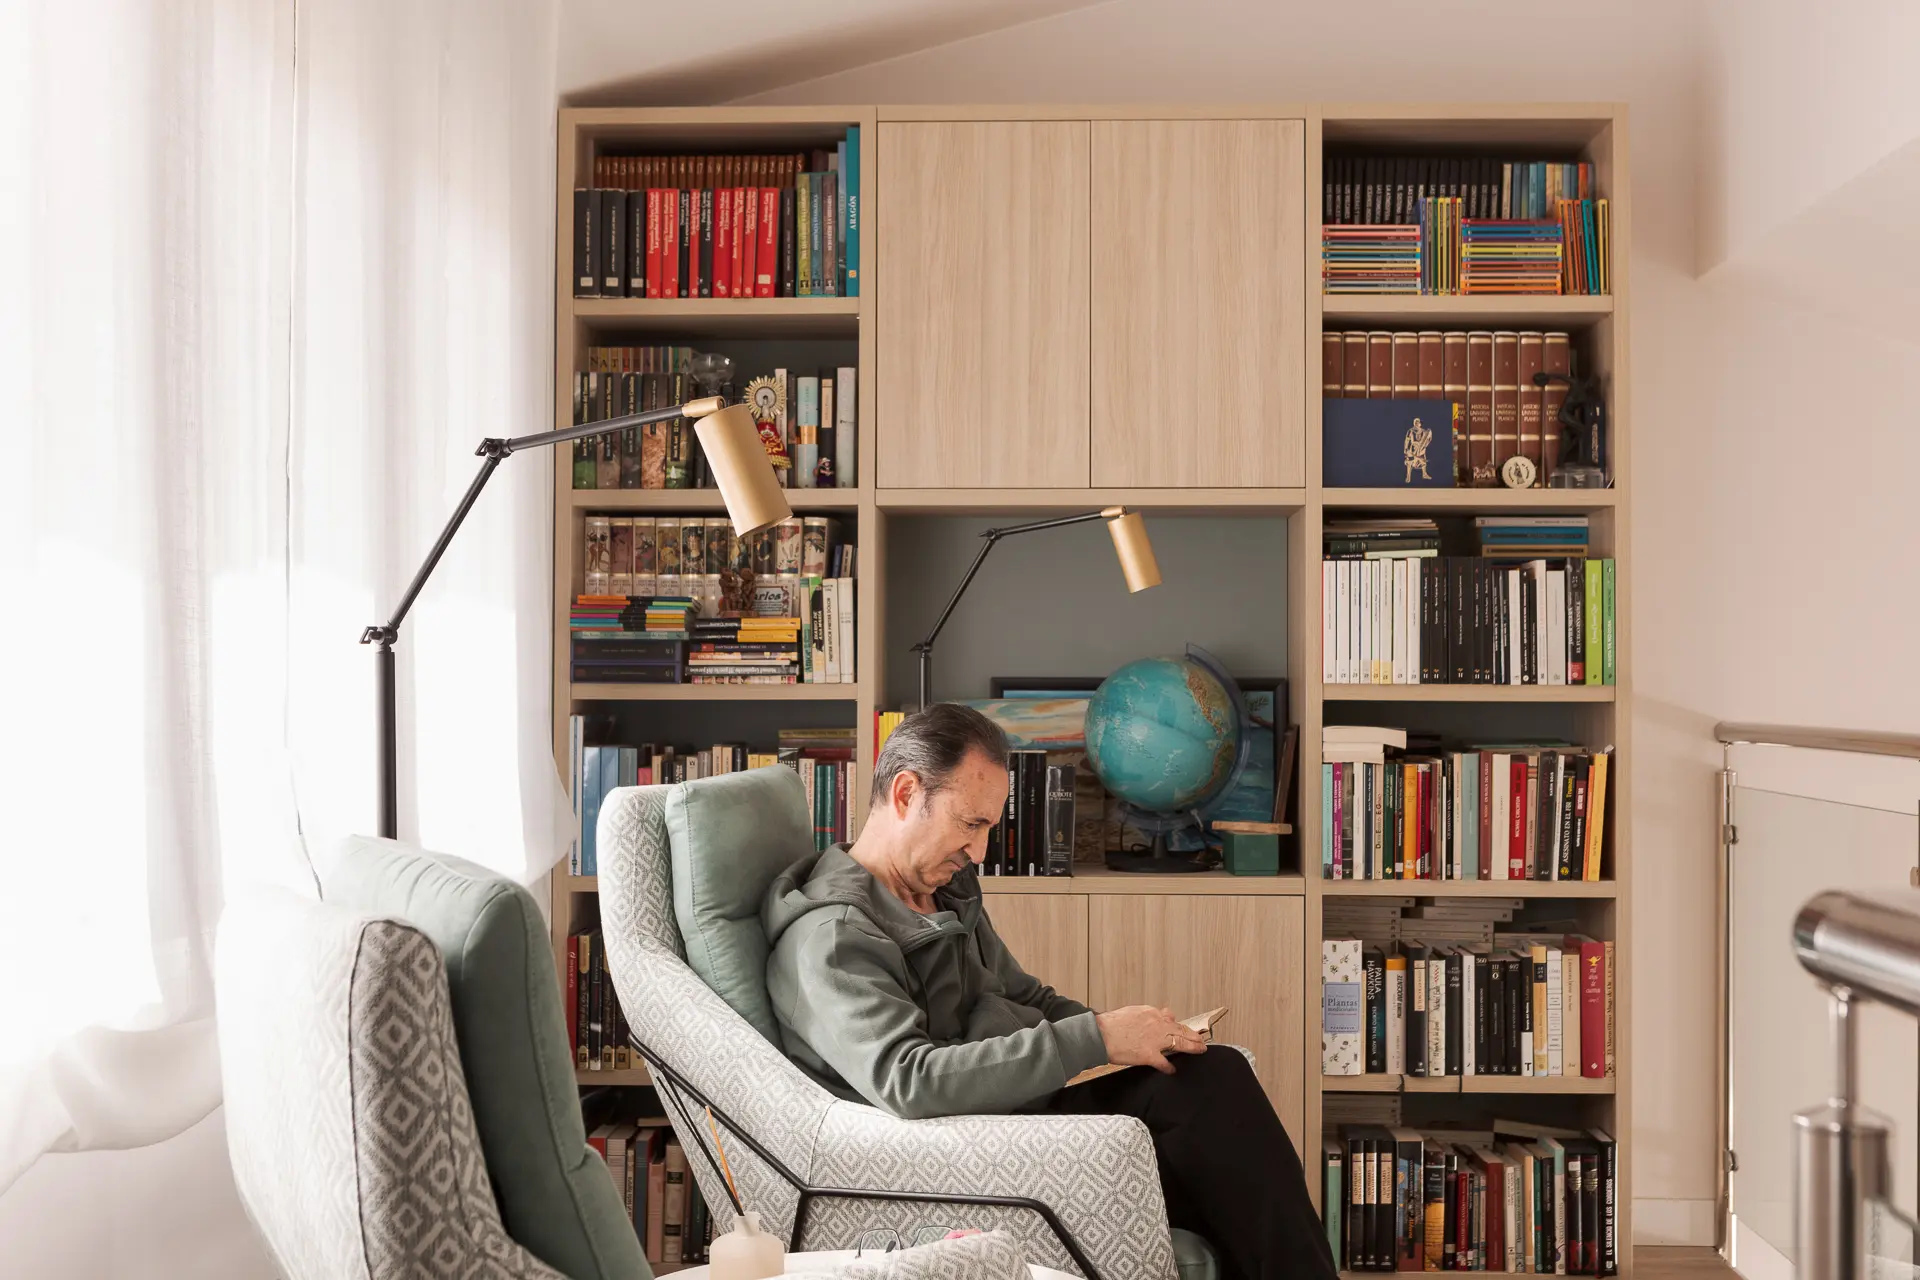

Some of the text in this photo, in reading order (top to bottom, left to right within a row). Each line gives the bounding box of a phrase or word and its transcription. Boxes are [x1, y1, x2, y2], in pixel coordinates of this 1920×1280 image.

[848, 196, 857, 230] ARAGÓN
[1562, 830, 1570, 863] ASESINATO
[1367, 960, 1375, 1000] HAWKINS
[1327, 998, 1358, 1006] Plantas
